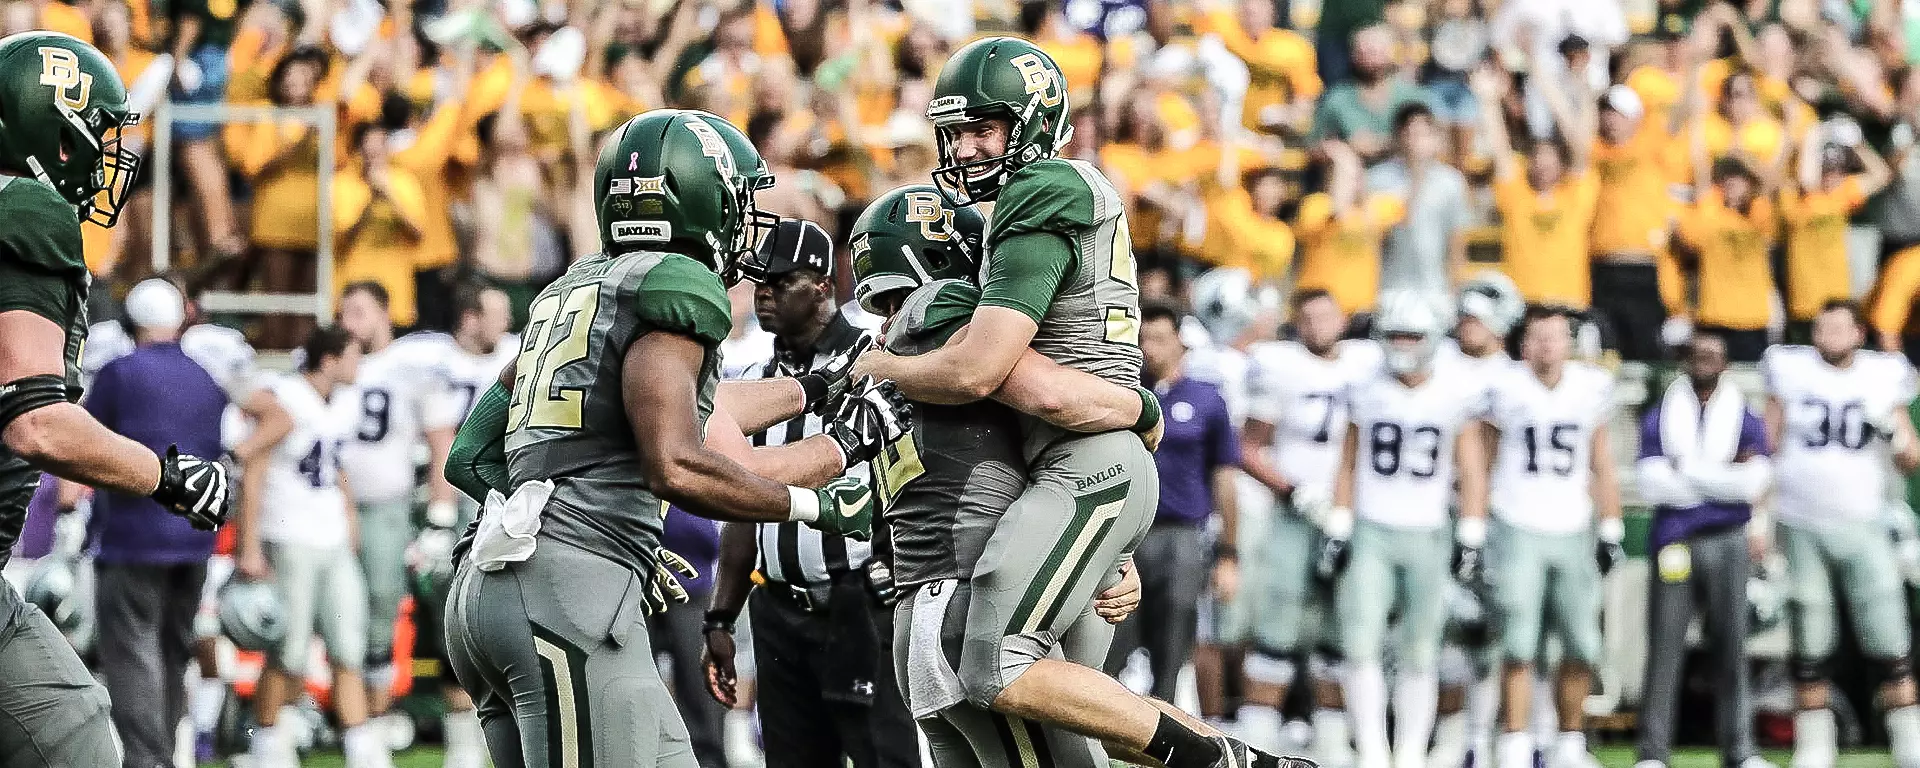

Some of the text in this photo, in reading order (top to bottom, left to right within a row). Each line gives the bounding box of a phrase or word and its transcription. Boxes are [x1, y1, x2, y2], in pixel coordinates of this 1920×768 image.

[617, 226, 662, 238] BAYLOR
[505, 281, 602, 435] 92
[1371, 421, 1440, 476] 83
[1525, 423, 1579, 476] 15
[1803, 395, 1868, 450] 30
[1074, 463, 1125, 490] BAYLOR
